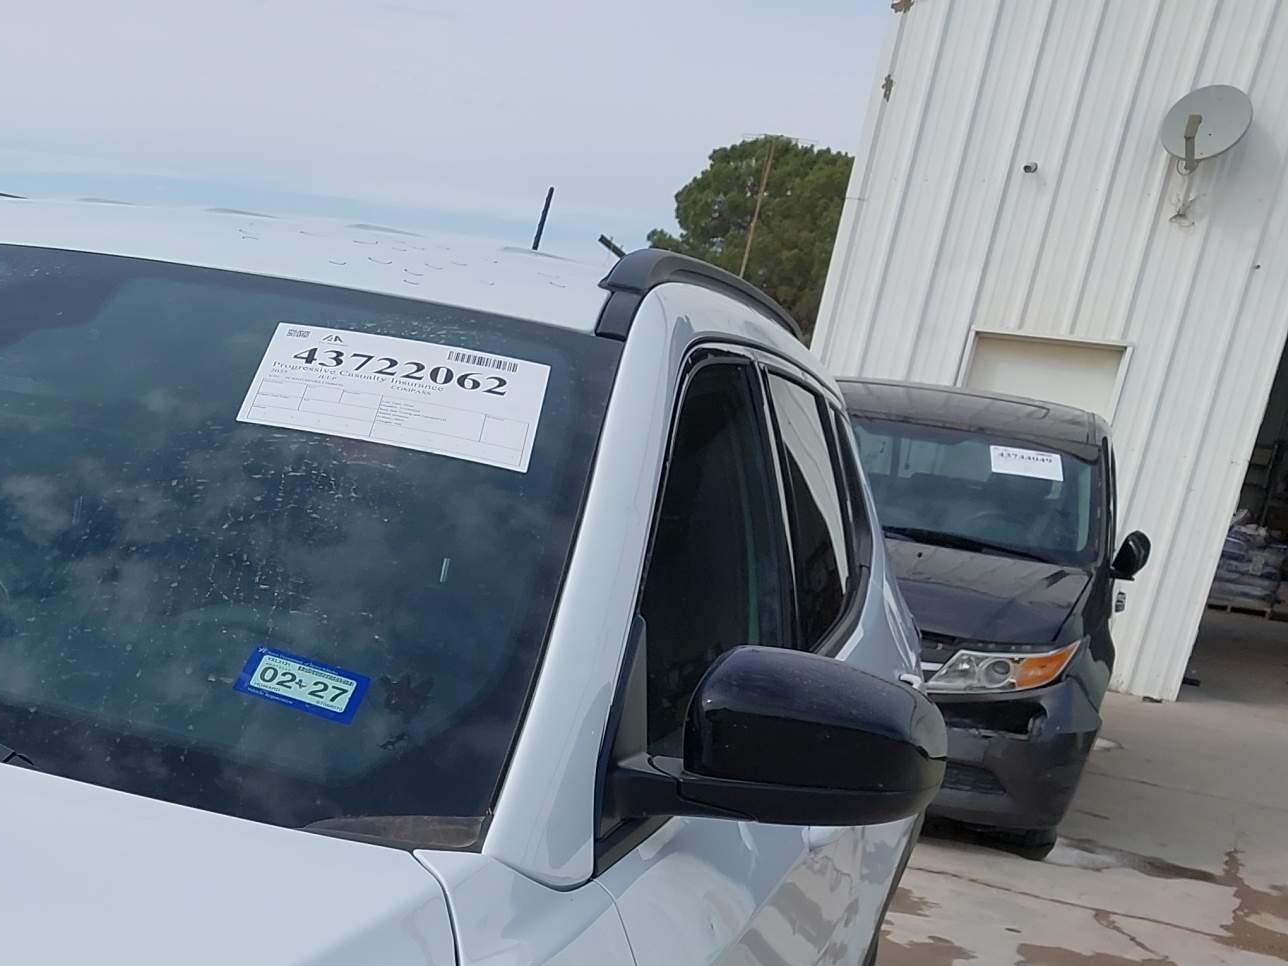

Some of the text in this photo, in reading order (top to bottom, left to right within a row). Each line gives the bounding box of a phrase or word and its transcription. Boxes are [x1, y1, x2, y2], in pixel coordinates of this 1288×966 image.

[272, 360, 337, 375] Progressive
[339, 368, 385, 384] Casualty
[391, 377, 445, 392] Insurance
[293, 347, 507, 397] 43722062
[259, 666, 297, 689] 02
[308, 681, 348, 703] 27
